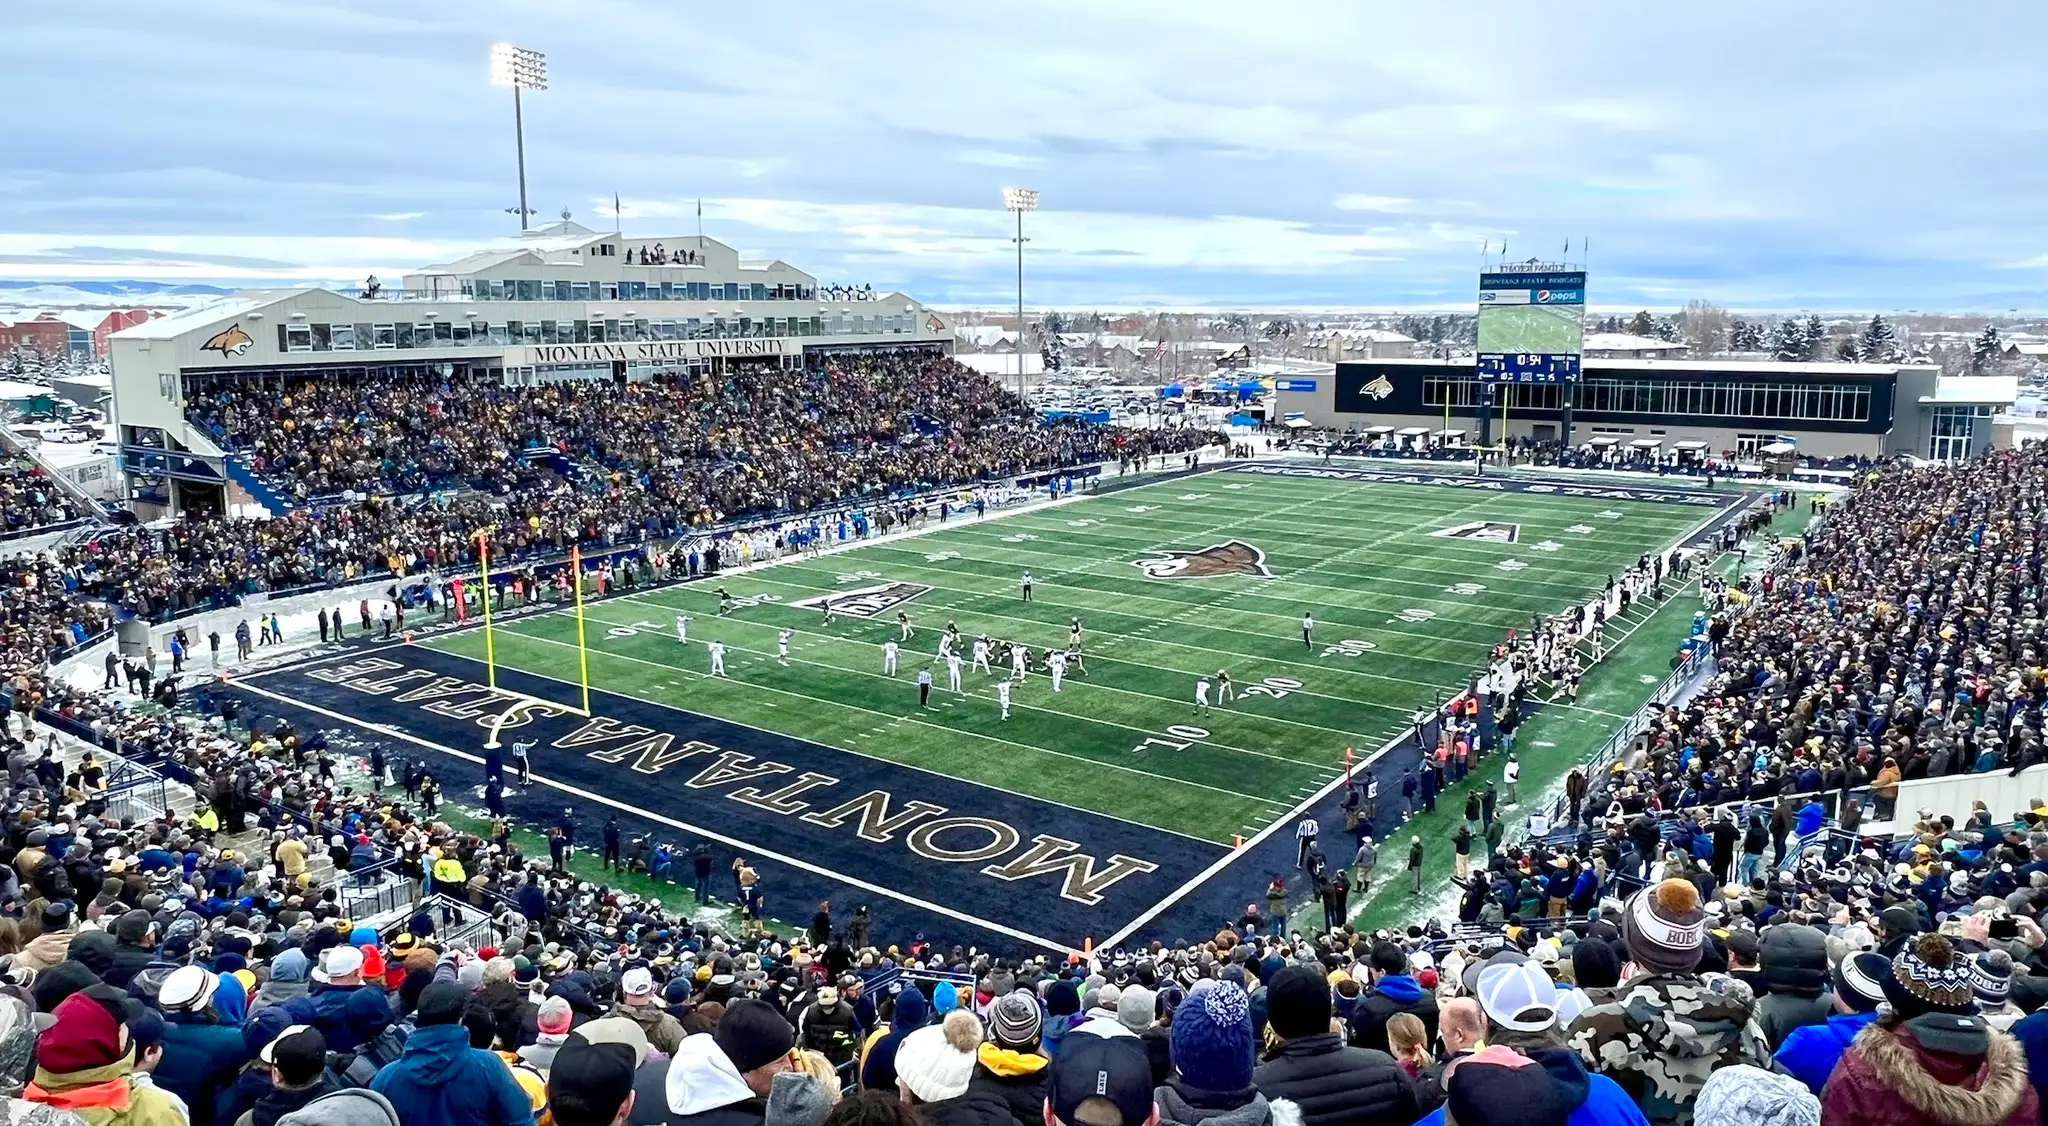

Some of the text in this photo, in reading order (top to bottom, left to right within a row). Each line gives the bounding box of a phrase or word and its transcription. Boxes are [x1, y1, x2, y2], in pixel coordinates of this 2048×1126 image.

[1550, 291, 1576, 301] pepsi
[535, 339, 785, 363] MONTANA STATE UNIVERSITY
[1238, 466, 1721, 505] MONTANA STATE
[607, 620, 667, 636] 10
[1326, 639, 1377, 657] 30
[1246, 676, 1303, 699] 20
[1145, 724, 1211, 752] 10
[304, 657, 1159, 906] MONTANA STATE
